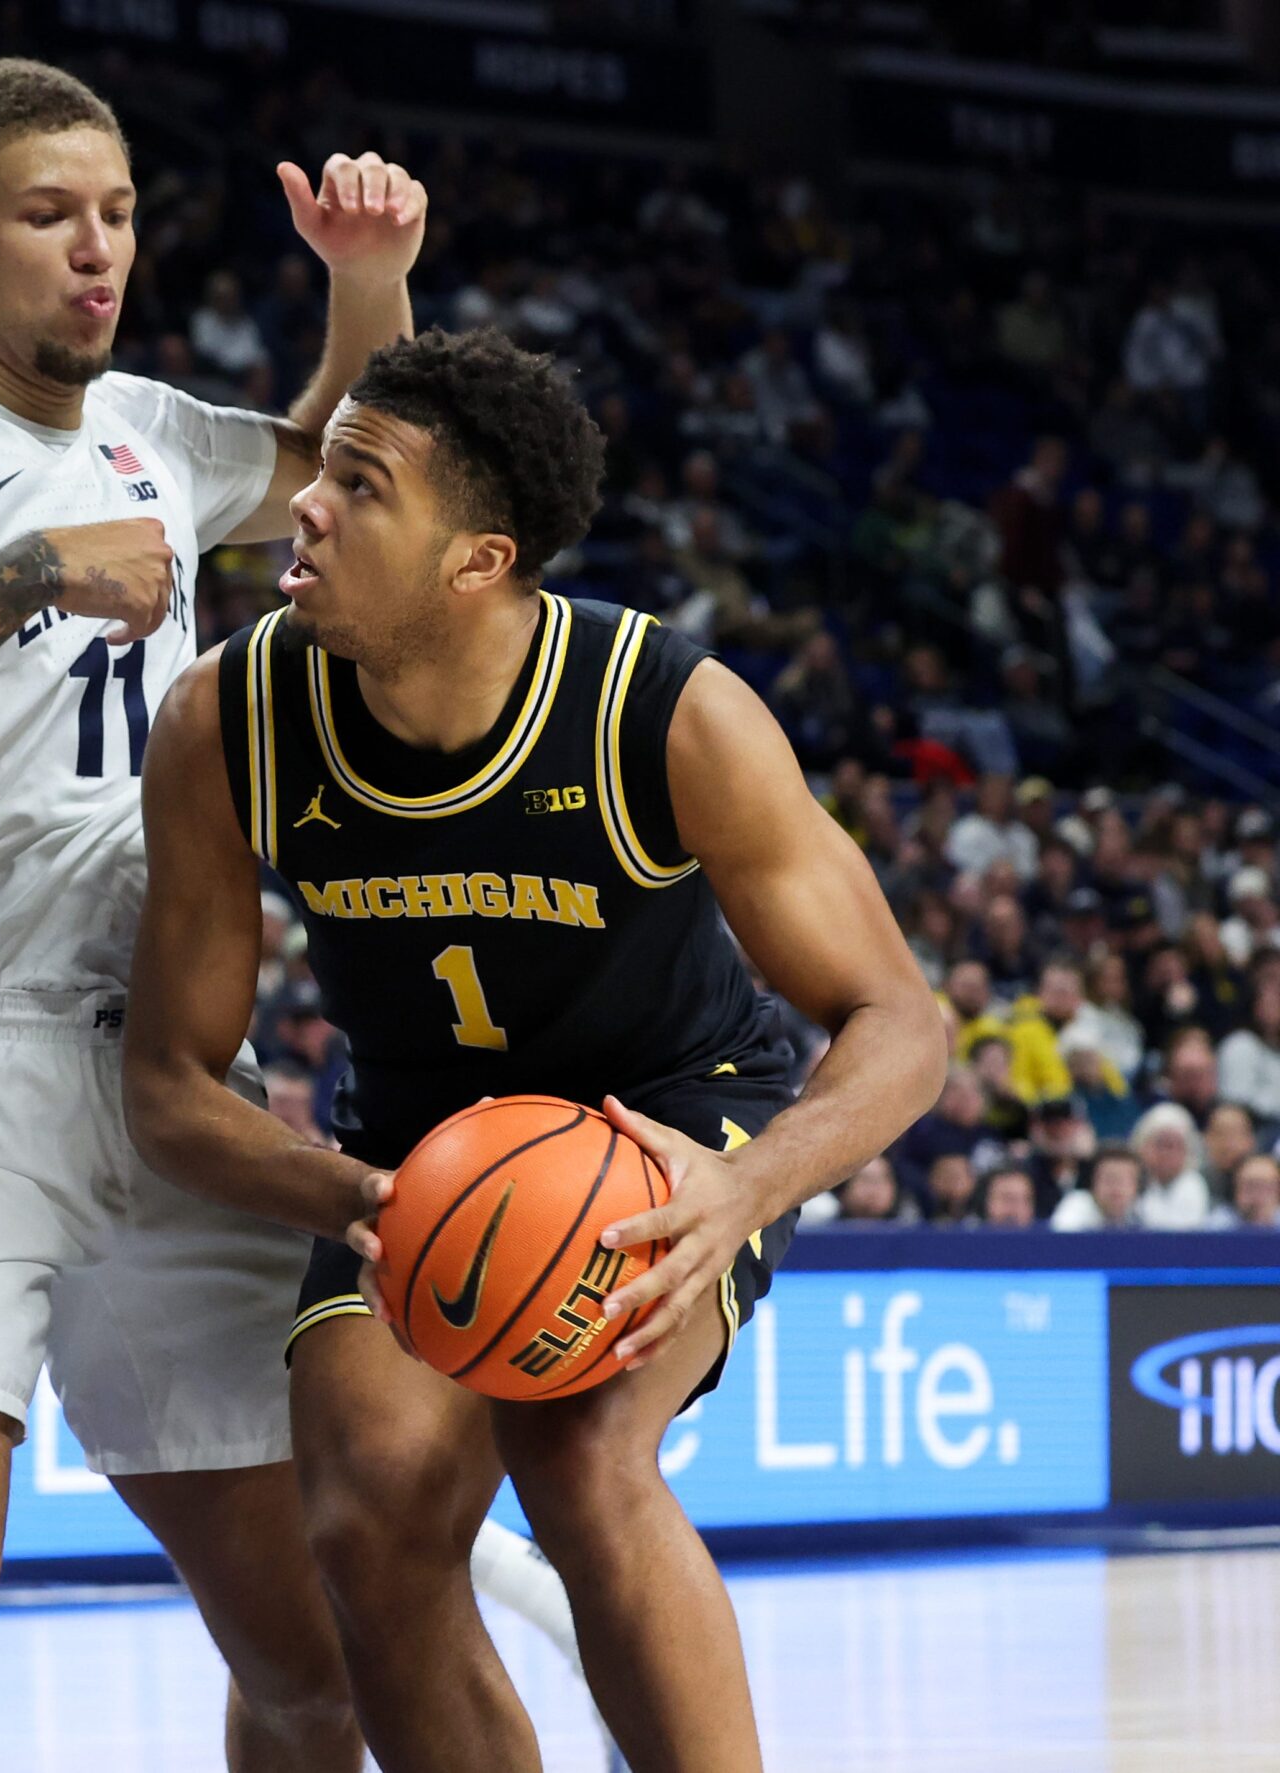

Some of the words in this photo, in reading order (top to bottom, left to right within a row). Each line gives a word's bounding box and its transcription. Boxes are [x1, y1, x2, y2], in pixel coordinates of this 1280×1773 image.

[69, 637, 150, 777] 11
[297, 872, 606, 929] MICHIGAN
[432, 945, 508, 1051] 1
[507, 1239, 630, 1378] ELITE
[754, 1290, 1021, 1469] Life.
